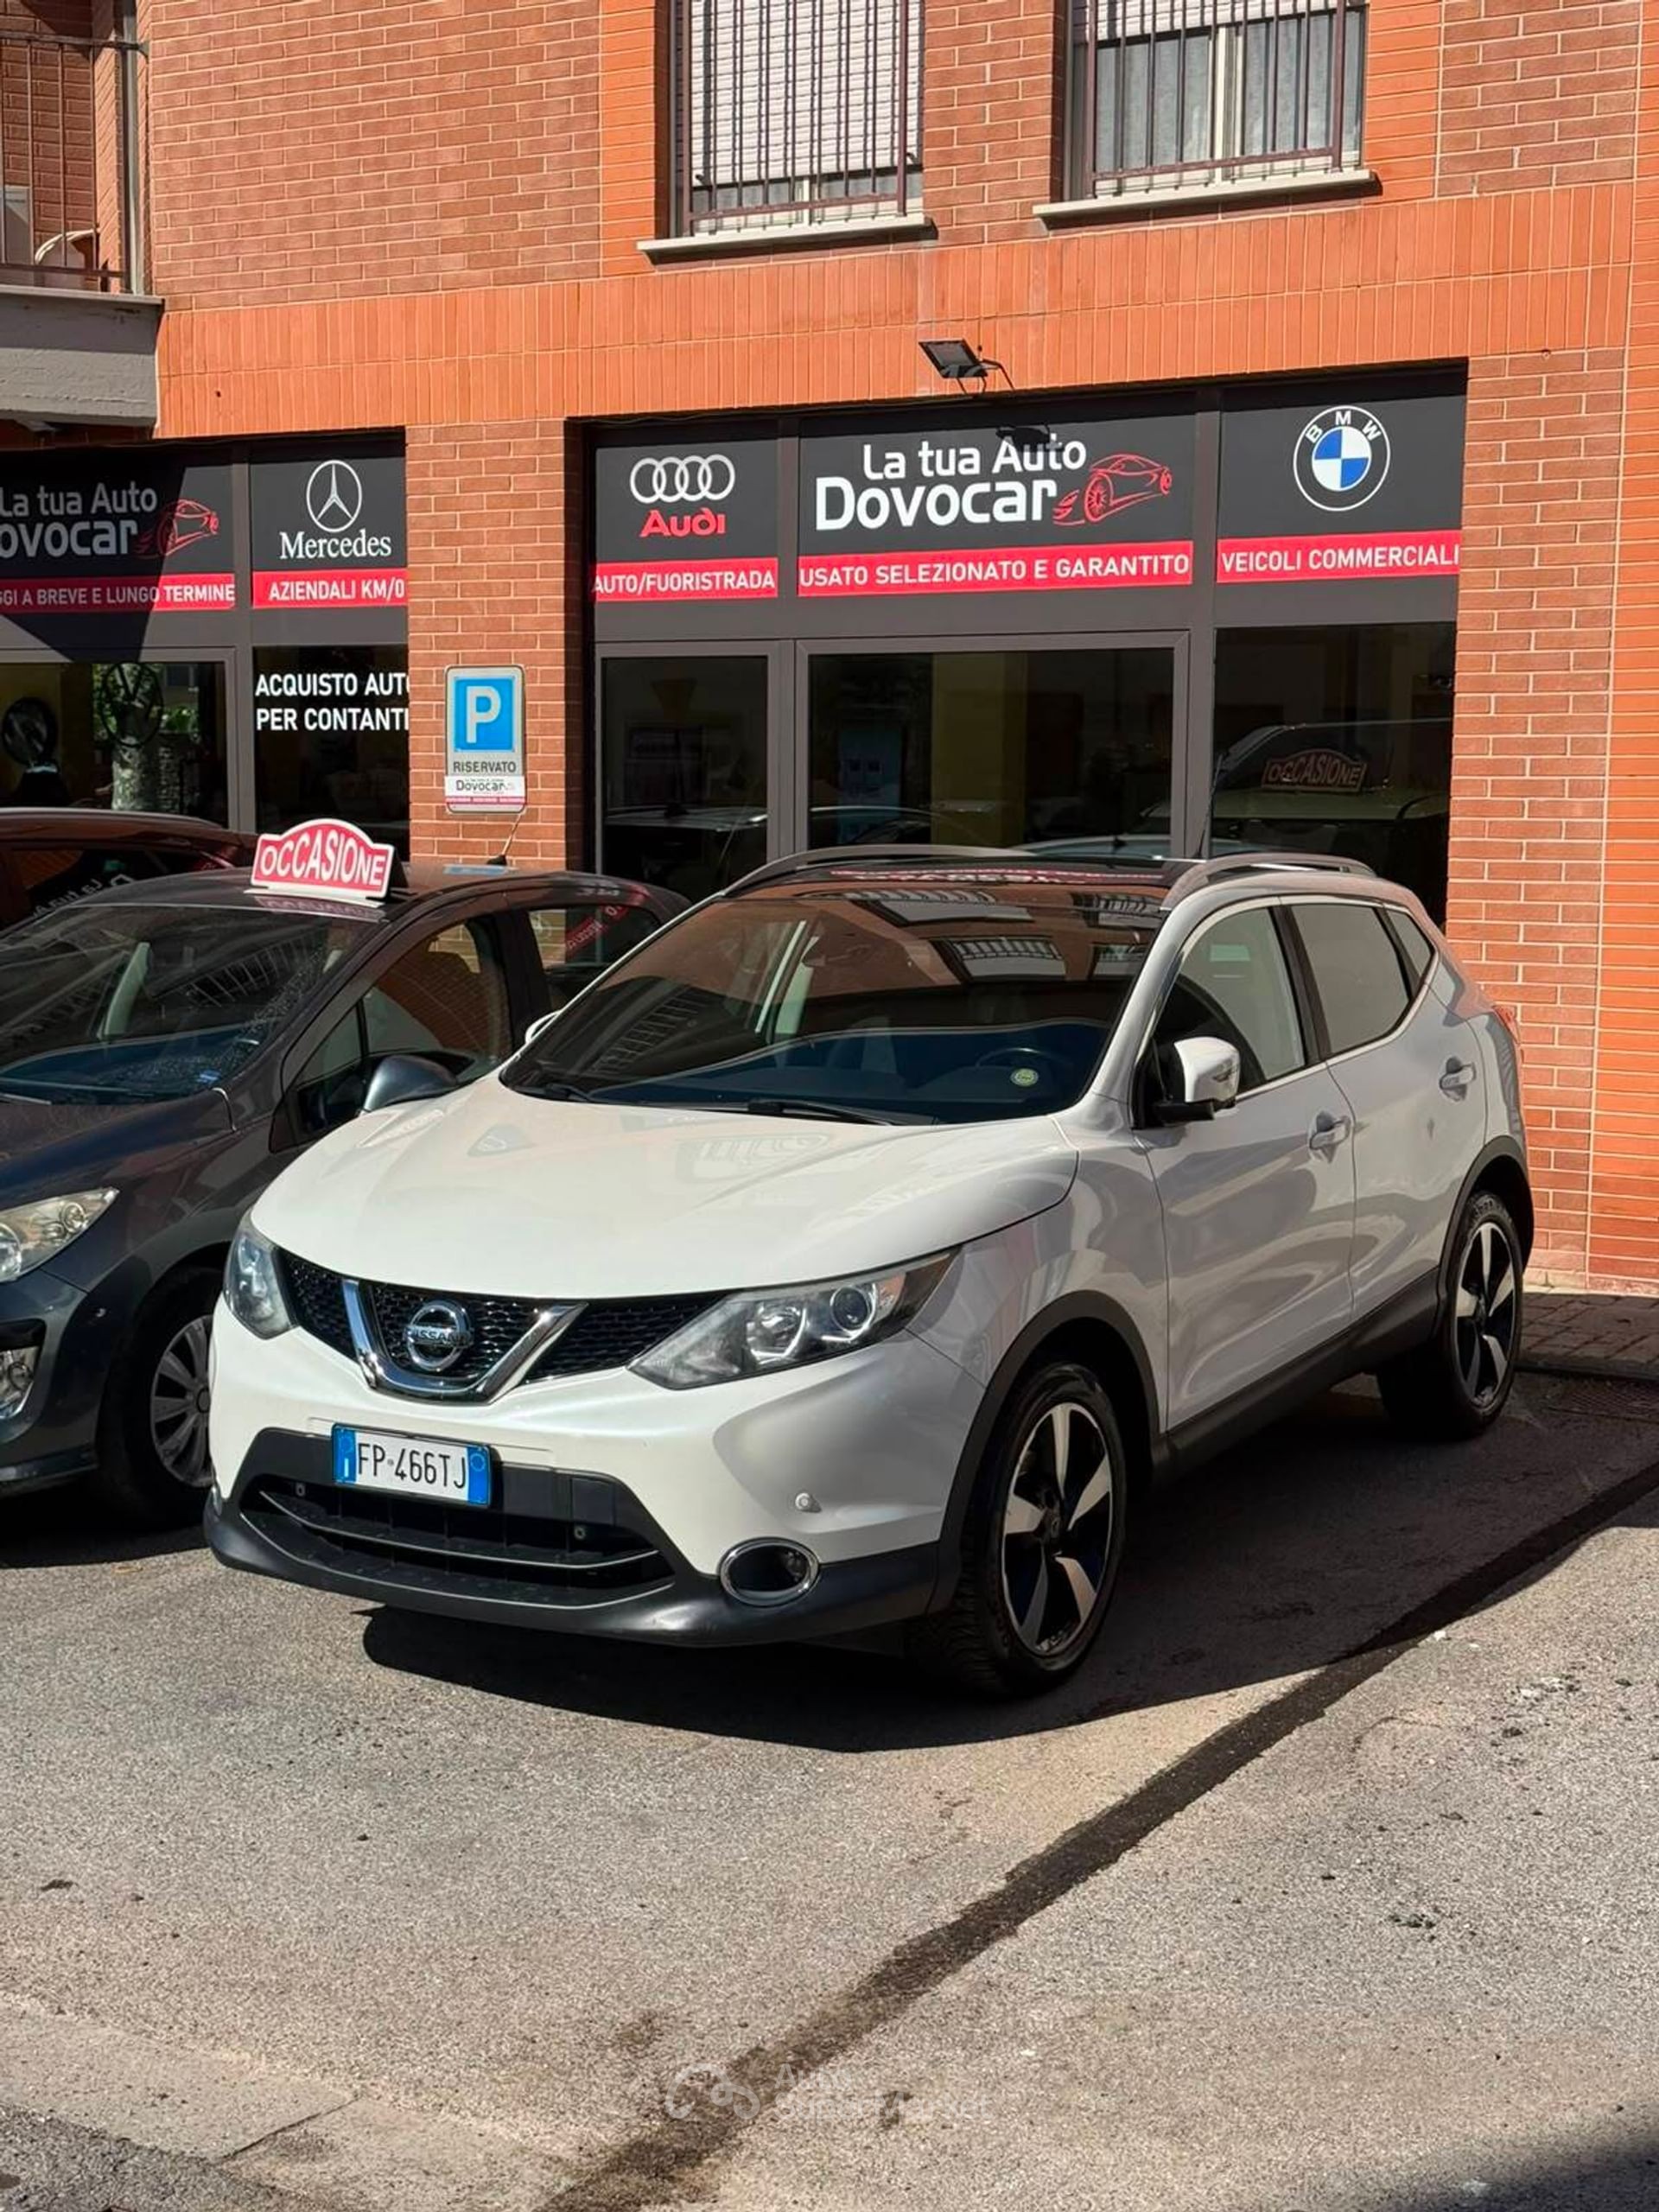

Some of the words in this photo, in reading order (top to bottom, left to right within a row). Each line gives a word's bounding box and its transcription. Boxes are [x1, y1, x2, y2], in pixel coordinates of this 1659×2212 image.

[1305, 410, 1382, 444] BMW
[864, 444, 906, 480] La
[918, 441, 981, 477] tua
[992, 434, 1087, 472] Auto
[0, 486, 29, 518] La
[37, 485, 82, 516] tua
[91, 480, 157, 514] Auto
[816, 476, 1058, 531] Dovocar
[639, 507, 727, 537] Audi
[279, 528, 391, 559] Mercedes
[1222, 550, 1301, 573] VEICOLI
[1308, 544, 1459, 570] COMMERCIALI
[592, 570, 775, 594] AUTO/FUORISTRADA
[799, 566, 868, 587] USATO
[875, 560, 1027, 584] SELEZIONATO
[1034, 560, 1047, 579] E
[1056, 554, 1189, 577] GARANTITO
[22, 589, 33, 605] A
[36, 588, 87, 605] BREVE
[92, 588, 102, 603] E
[106, 586, 159, 603] LUNGO
[162, 584, 235, 602] TERMINE
[268, 580, 356, 601] AZIENDALI
[361, 577, 405, 603] KM/0
[255, 673, 358, 696] ACQUISTO
[364, 672, 410, 696] AUT
[256, 708, 298, 730] PER
[304, 708, 410, 730] CONTANTI
[466, 685, 501, 743] P
[454, 761, 517, 773] RISERVATO
[455, 779, 505, 791] Dovocar
[260, 829, 386, 887] OCCASIONE
